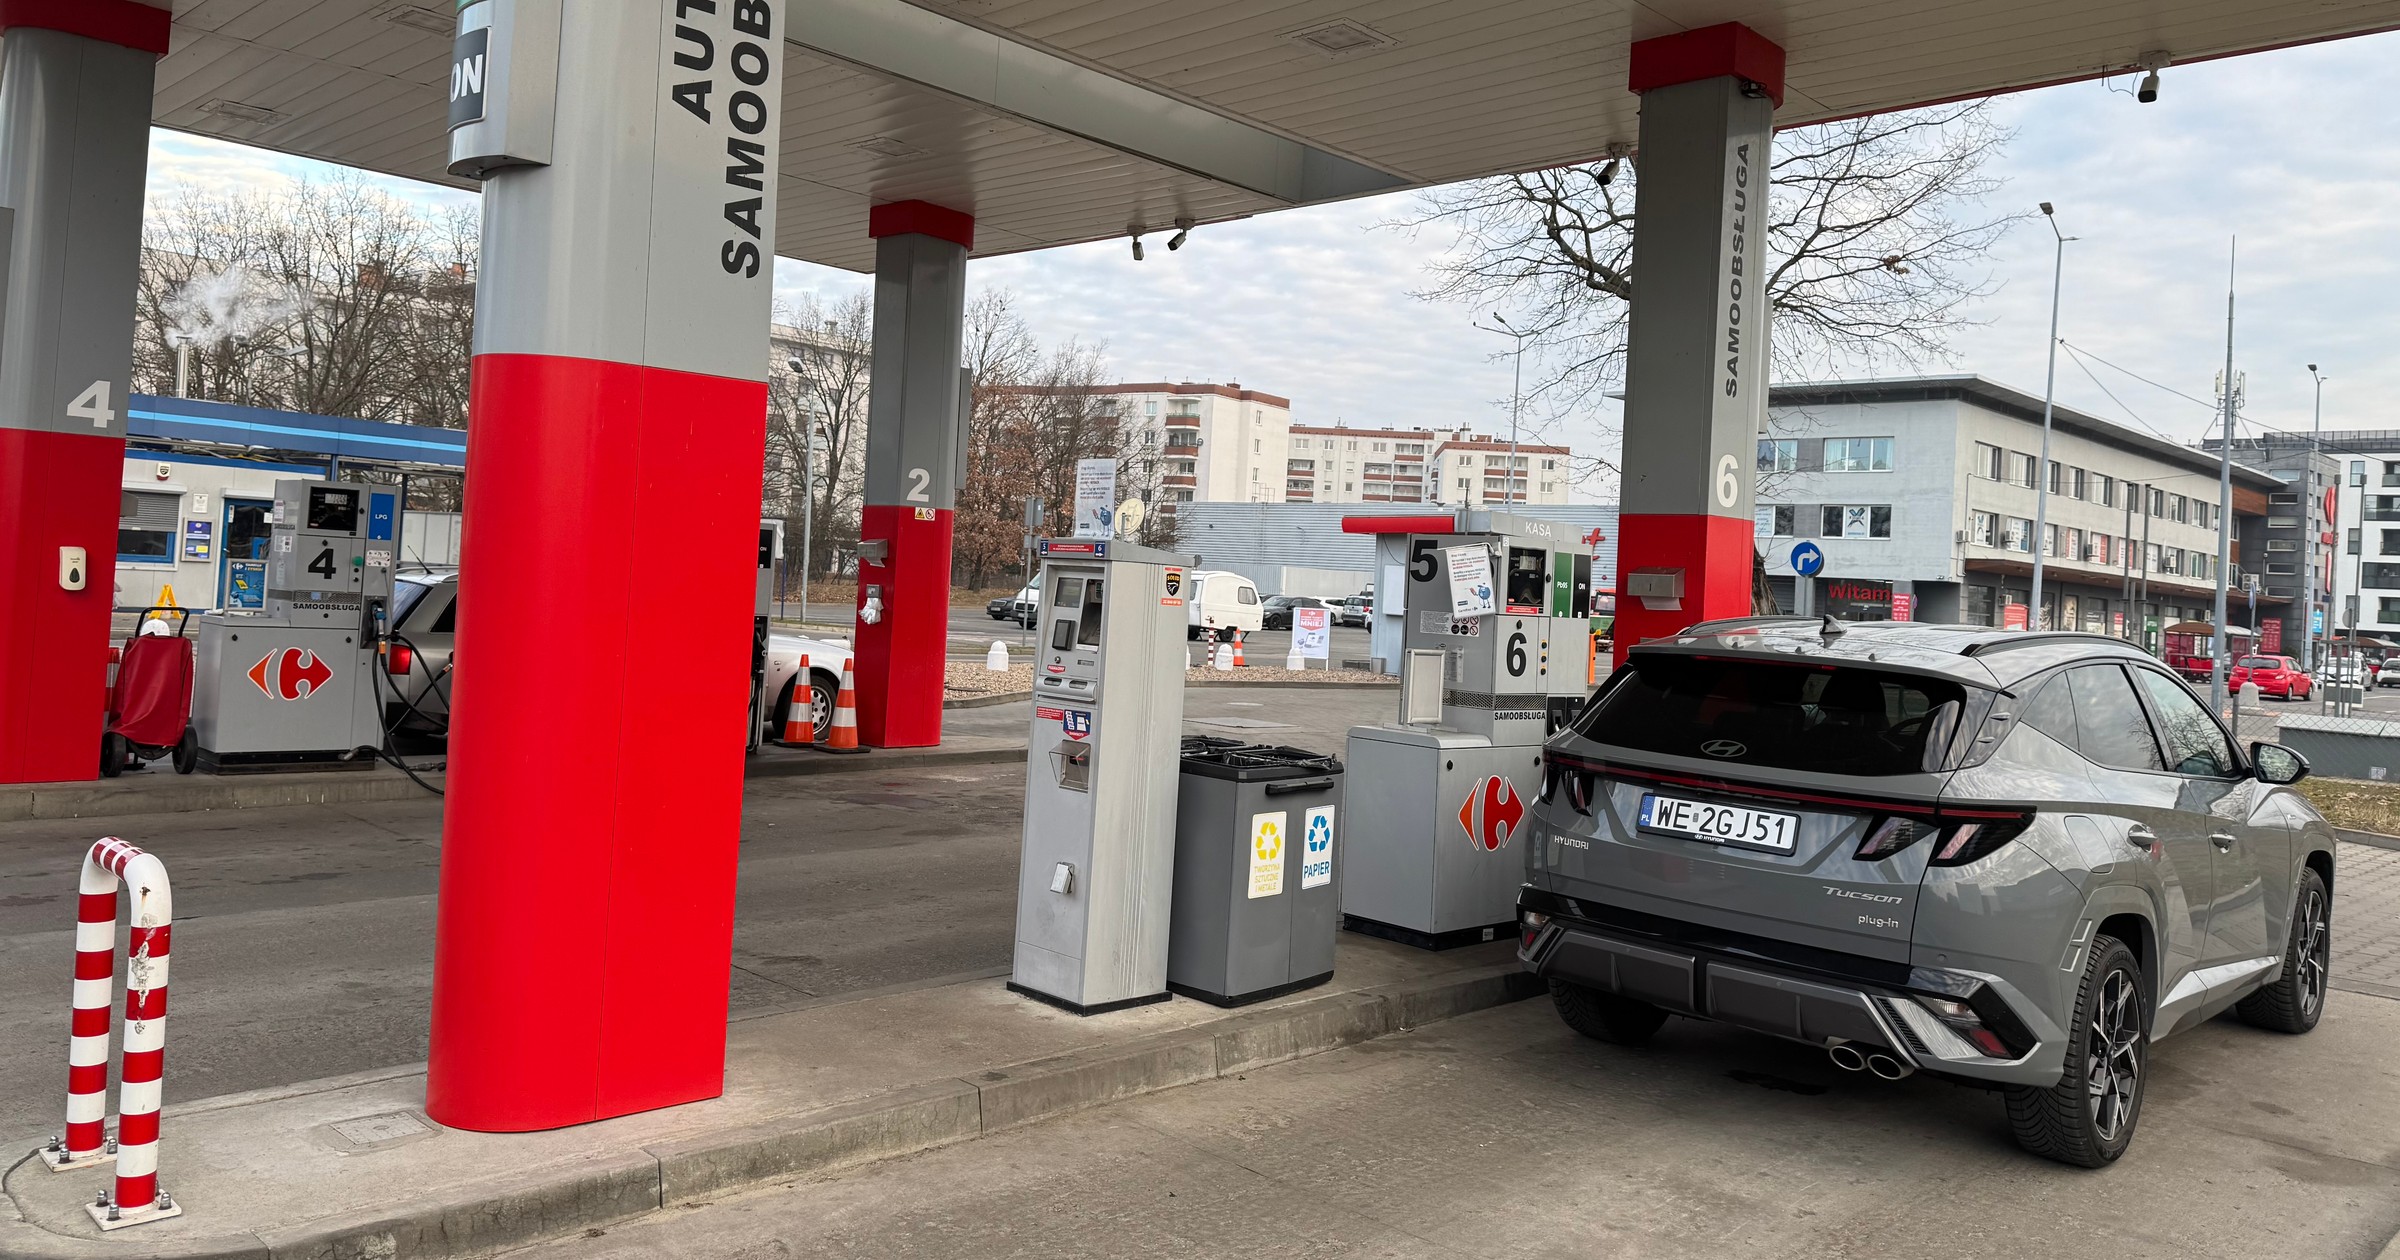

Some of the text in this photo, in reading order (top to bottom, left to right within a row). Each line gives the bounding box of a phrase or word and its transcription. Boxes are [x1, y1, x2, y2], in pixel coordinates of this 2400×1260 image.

[1725, 143, 1749, 398] SAMOOBSŁUGA
[67, 380, 115, 428] 4
[906, 468, 930, 502] 2
[1716, 454, 1739, 508] 6
[1525, 521, 1552, 537] KASA
[308, 548, 336, 579] 4
[1410, 540, 1438, 582] 5
[1556, 581, 1568, 589] Pb95
[293, 603, 360, 611] SAMOOBSŁUGA
[1506, 632, 1527, 677] 6
[1494, 711, 1546, 720] SAMOOBSŁUGA
[1641, 814, 1650, 822] PL
[1657, 799, 1786, 845] WE 2GJ51
[1554, 835, 1589, 850] HYUNDAI
[1255, 873, 1279, 883] SZTUCZNE
[1303, 861, 1330, 879] PAPIER
[1258, 882, 1277, 892] METALE
[1858, 915, 1899, 928] plug-in
